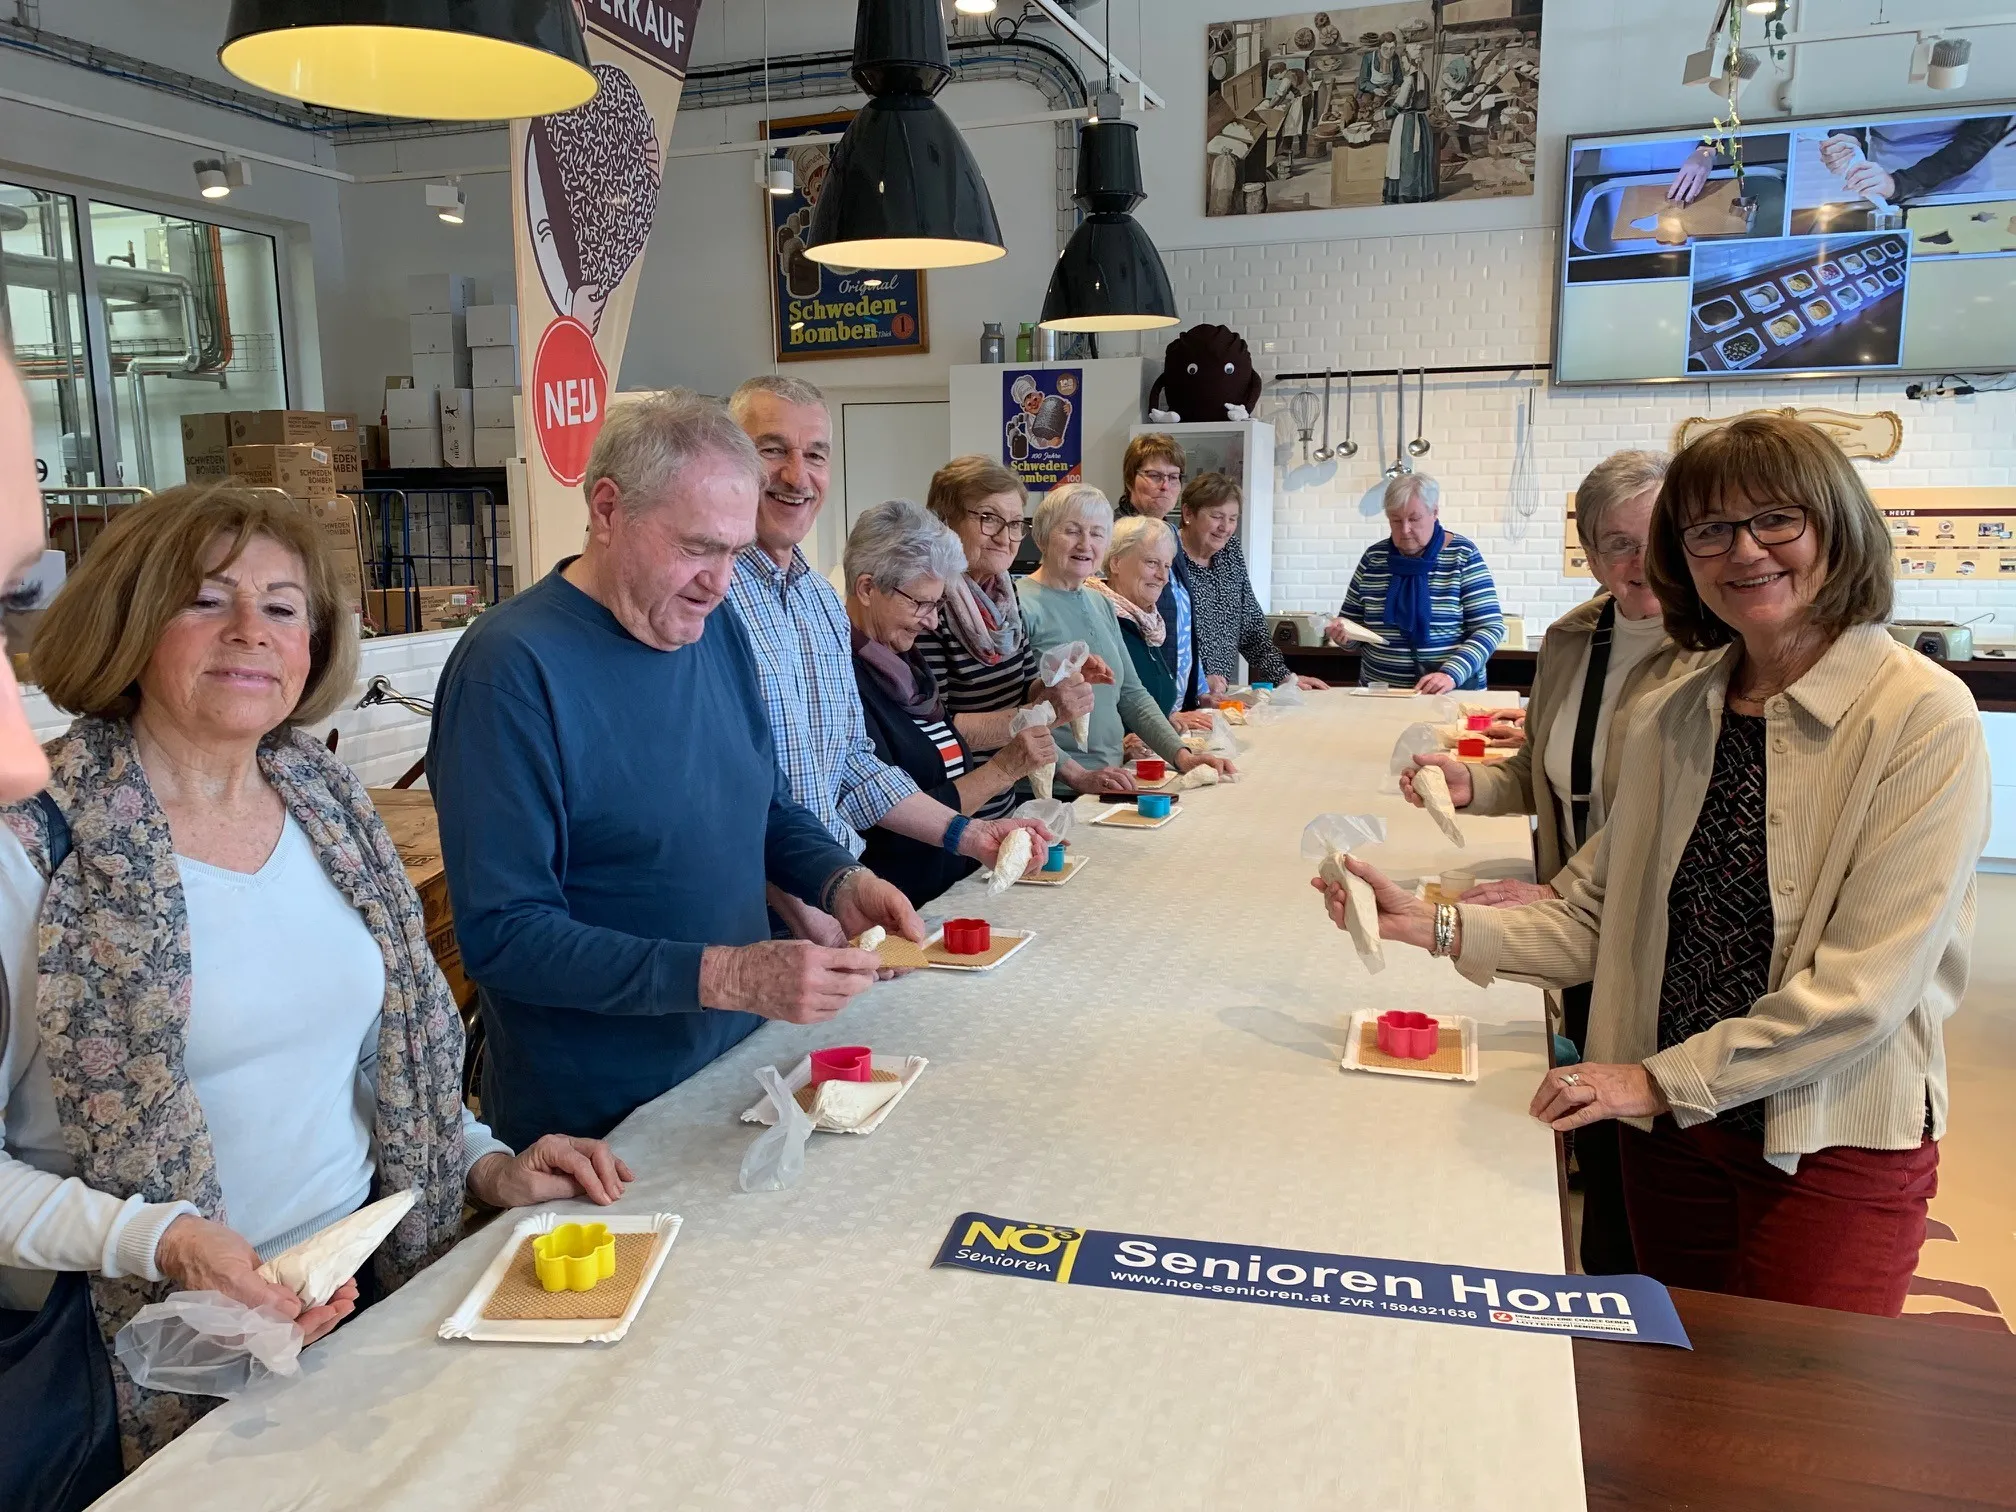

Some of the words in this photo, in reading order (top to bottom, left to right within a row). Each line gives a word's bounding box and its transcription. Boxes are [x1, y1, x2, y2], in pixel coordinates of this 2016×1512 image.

[587, 0, 685, 54] RKAUF
[789, 295, 908, 322] Schweden-
[789, 319, 878, 345] Bomben
[544, 377, 598, 430] NEU
[186, 455, 226, 466] SCHWEDEN
[333, 454, 357, 463] EDEN
[196, 465, 226, 475] BOMBEN
[333, 464, 358, 473] MBEN
[1010, 460, 1074, 472] Schweden-
[300, 469, 333, 477] SCHWEDEN
[1018, 473, 1058, 483] omben
[308, 476, 333, 485] BOMBEN
[1066, 474, 1081, 483] 100
[322, 521, 351, 529] HWEDEN
[954, 1248, 1051, 1273] Senioren
[1114, 1240, 1423, 1299] Senioren
[1451, 1274, 1633, 1316] Horn
[1110, 1270, 1331, 1305] www.noe-senioren.at
[1339, 1296, 1375, 1309] ZVR
[1380, 1301, 1478, 1319] 1594321636
[1516, 1320, 1571, 1328] LOTTERIEN
